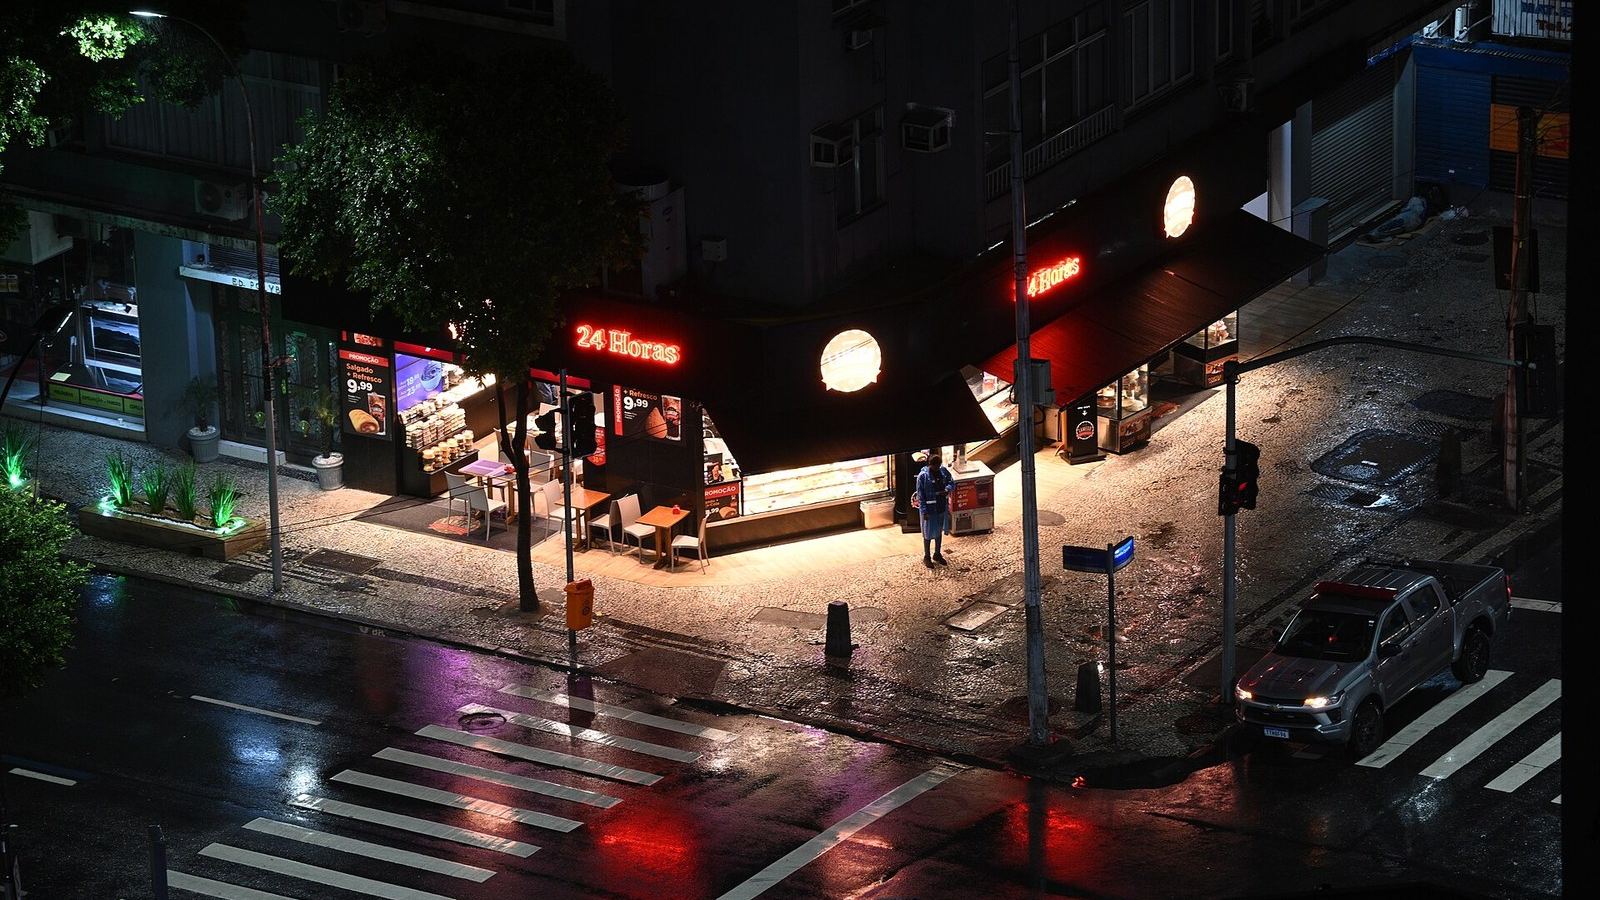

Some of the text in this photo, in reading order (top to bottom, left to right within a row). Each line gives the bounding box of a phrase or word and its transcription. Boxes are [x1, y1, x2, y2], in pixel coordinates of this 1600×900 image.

[1038, 257, 1080, 294] Horas
[577, 325, 681, 364] 24 Horas
[348, 353, 379, 364] PROMOÇÃO
[346, 362, 374, 374] Salgado
[352, 372, 382, 384] Refresco
[346, 378, 373, 393] 9,99
[629, 389, 658, 401] Refresco
[623, 396, 649, 410] 9,99
[704, 486, 737, 497] ROMOÇÃO
